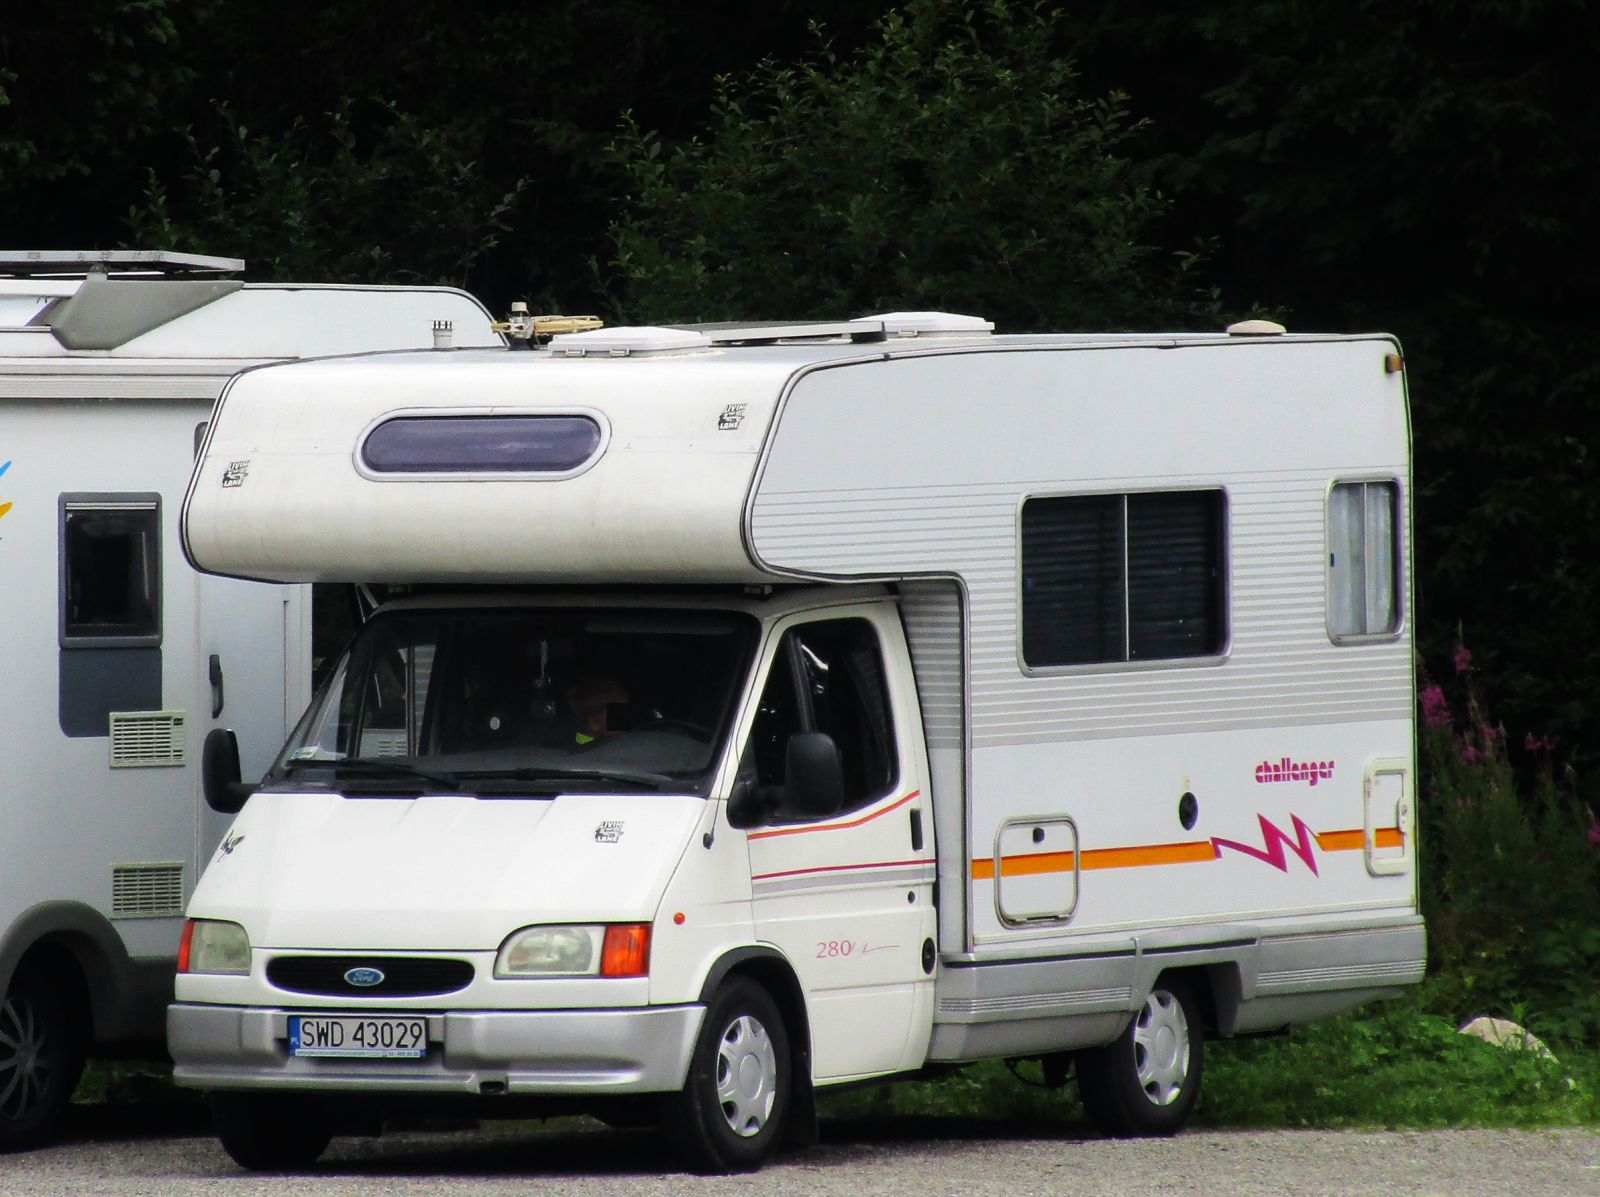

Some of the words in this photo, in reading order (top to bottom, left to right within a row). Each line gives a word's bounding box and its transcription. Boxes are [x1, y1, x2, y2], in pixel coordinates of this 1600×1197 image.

[1255, 757, 1335, 787] challenger
[816, 940, 852, 959] 280
[302, 1021, 344, 1047] SWD
[352, 1021, 423, 1048] 43029
